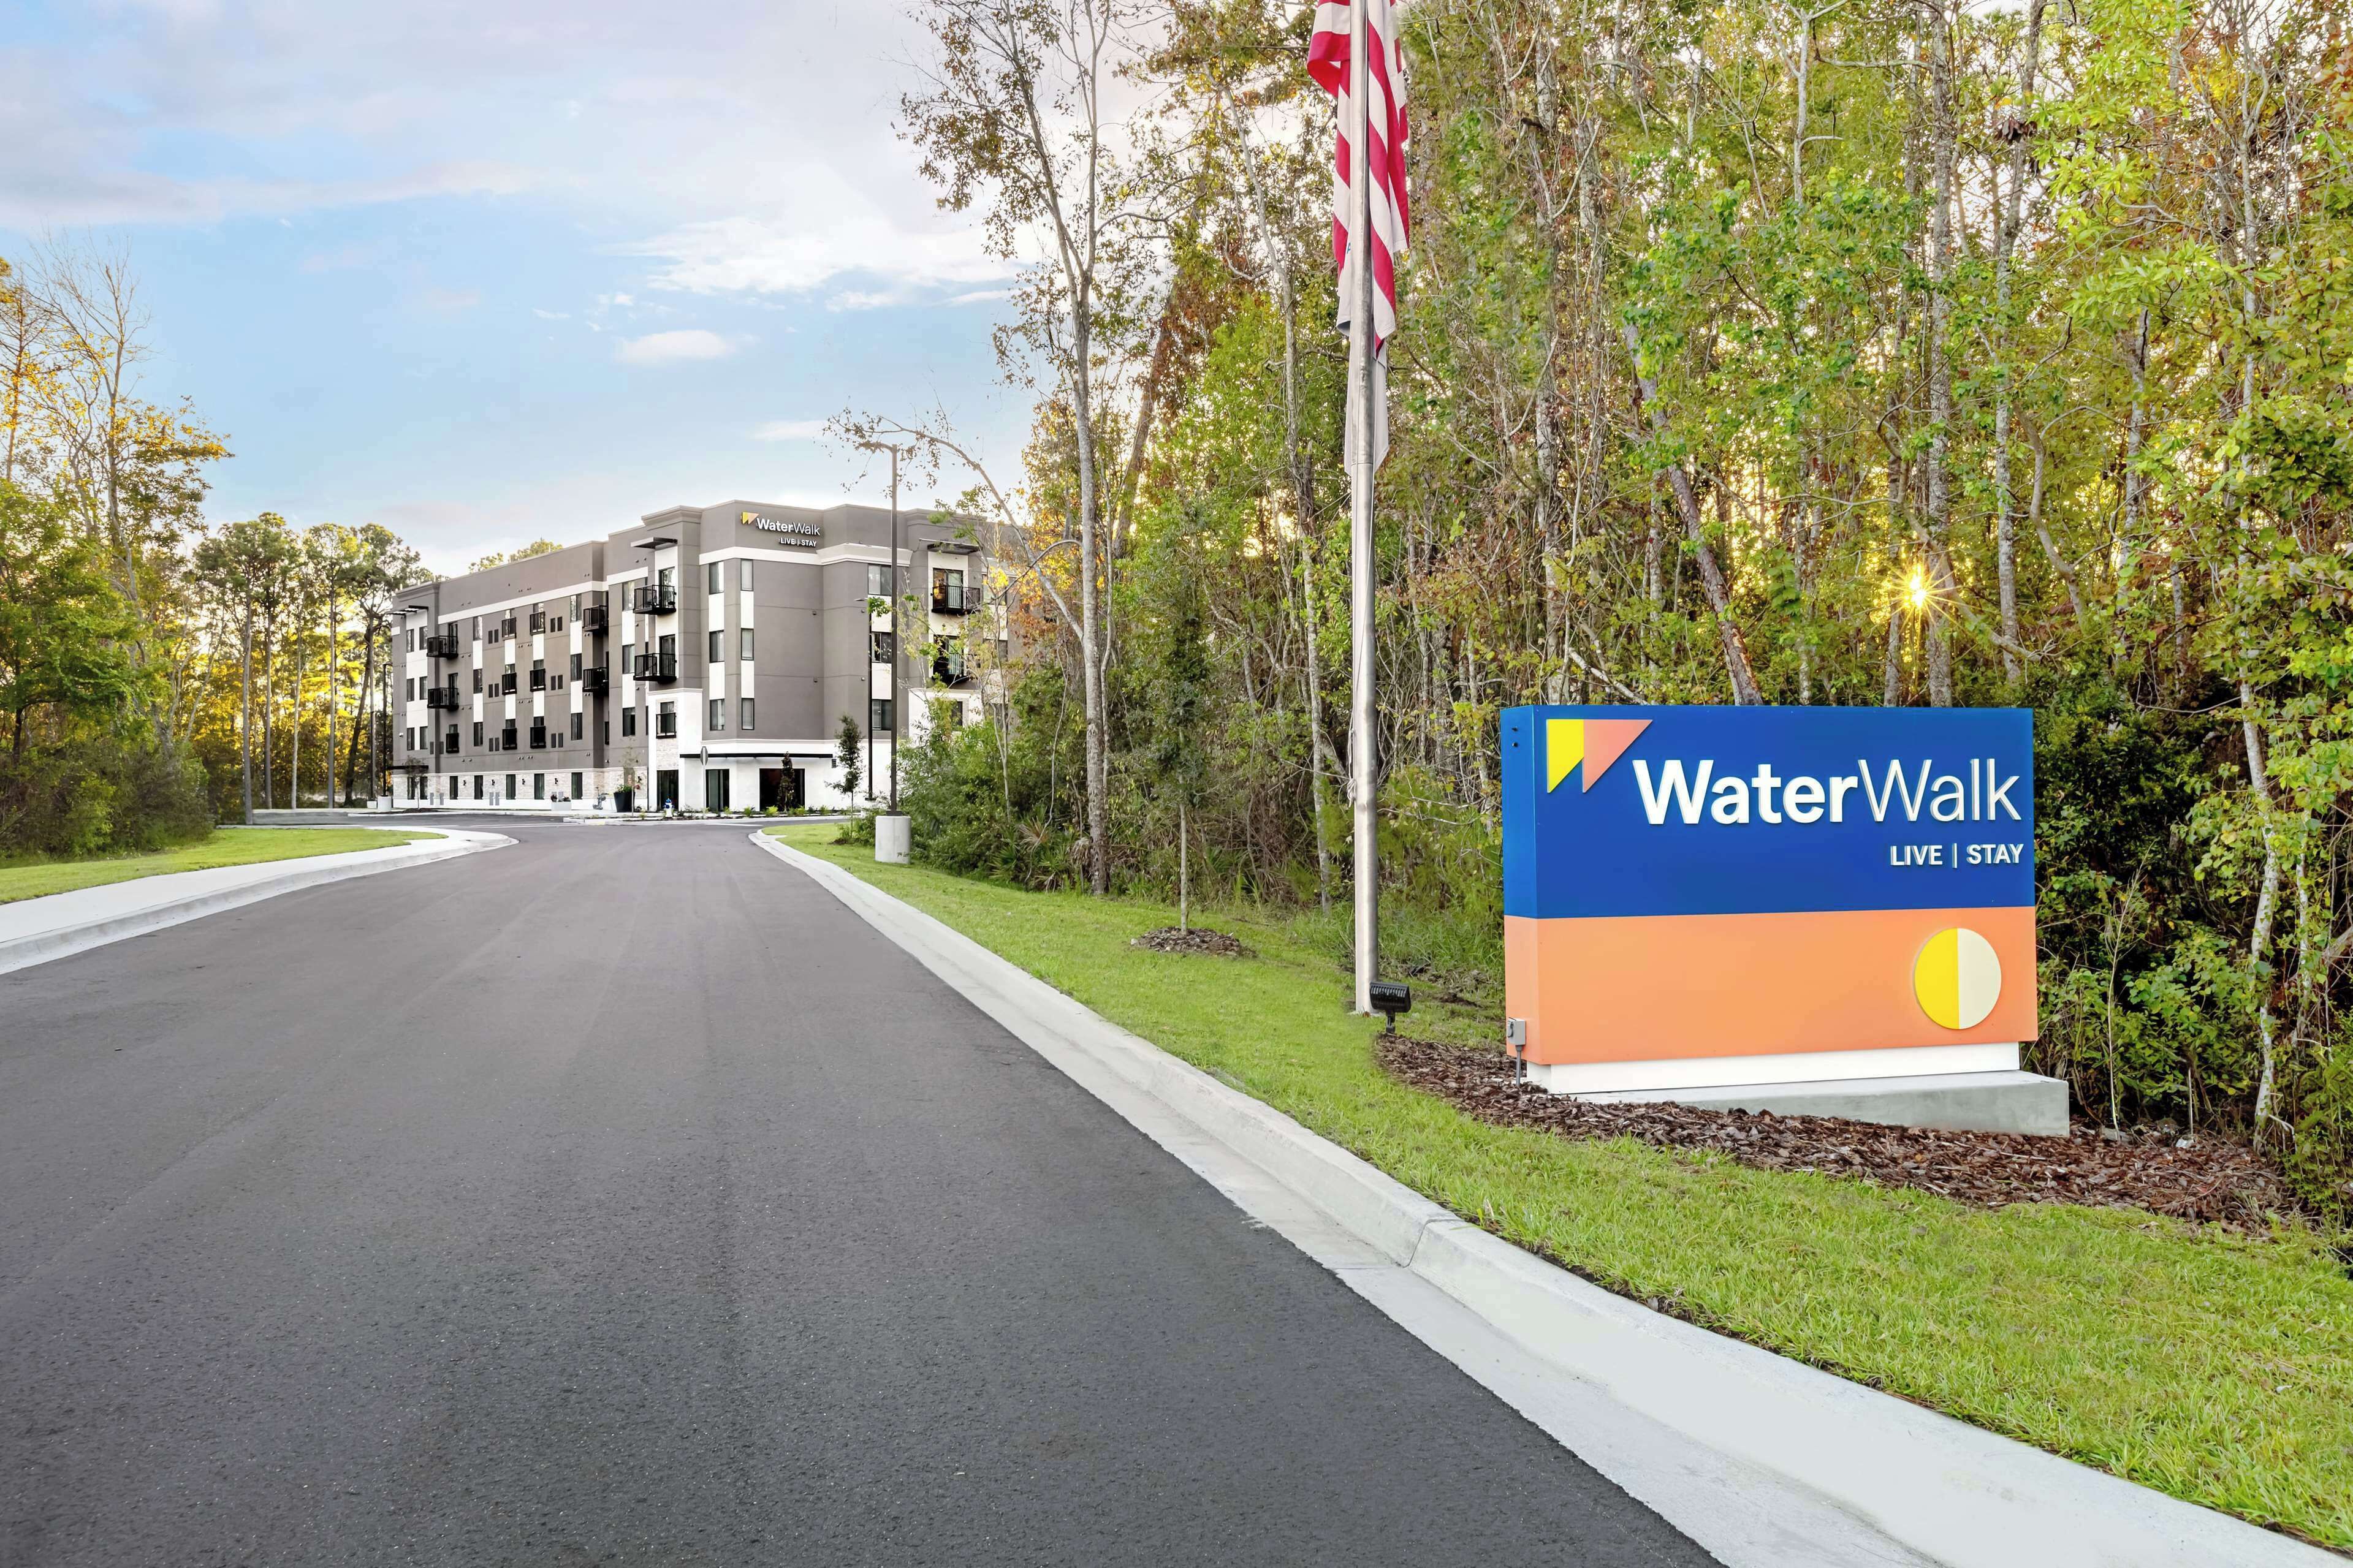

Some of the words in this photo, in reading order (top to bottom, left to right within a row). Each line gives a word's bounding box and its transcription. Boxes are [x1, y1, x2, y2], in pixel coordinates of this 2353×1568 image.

[756, 517, 821, 536] WaterWalk
[1632, 758, 2021, 825] WaterWalk
[1890, 845, 1943, 866] LIVE
[1966, 844, 2024, 865] STAY
